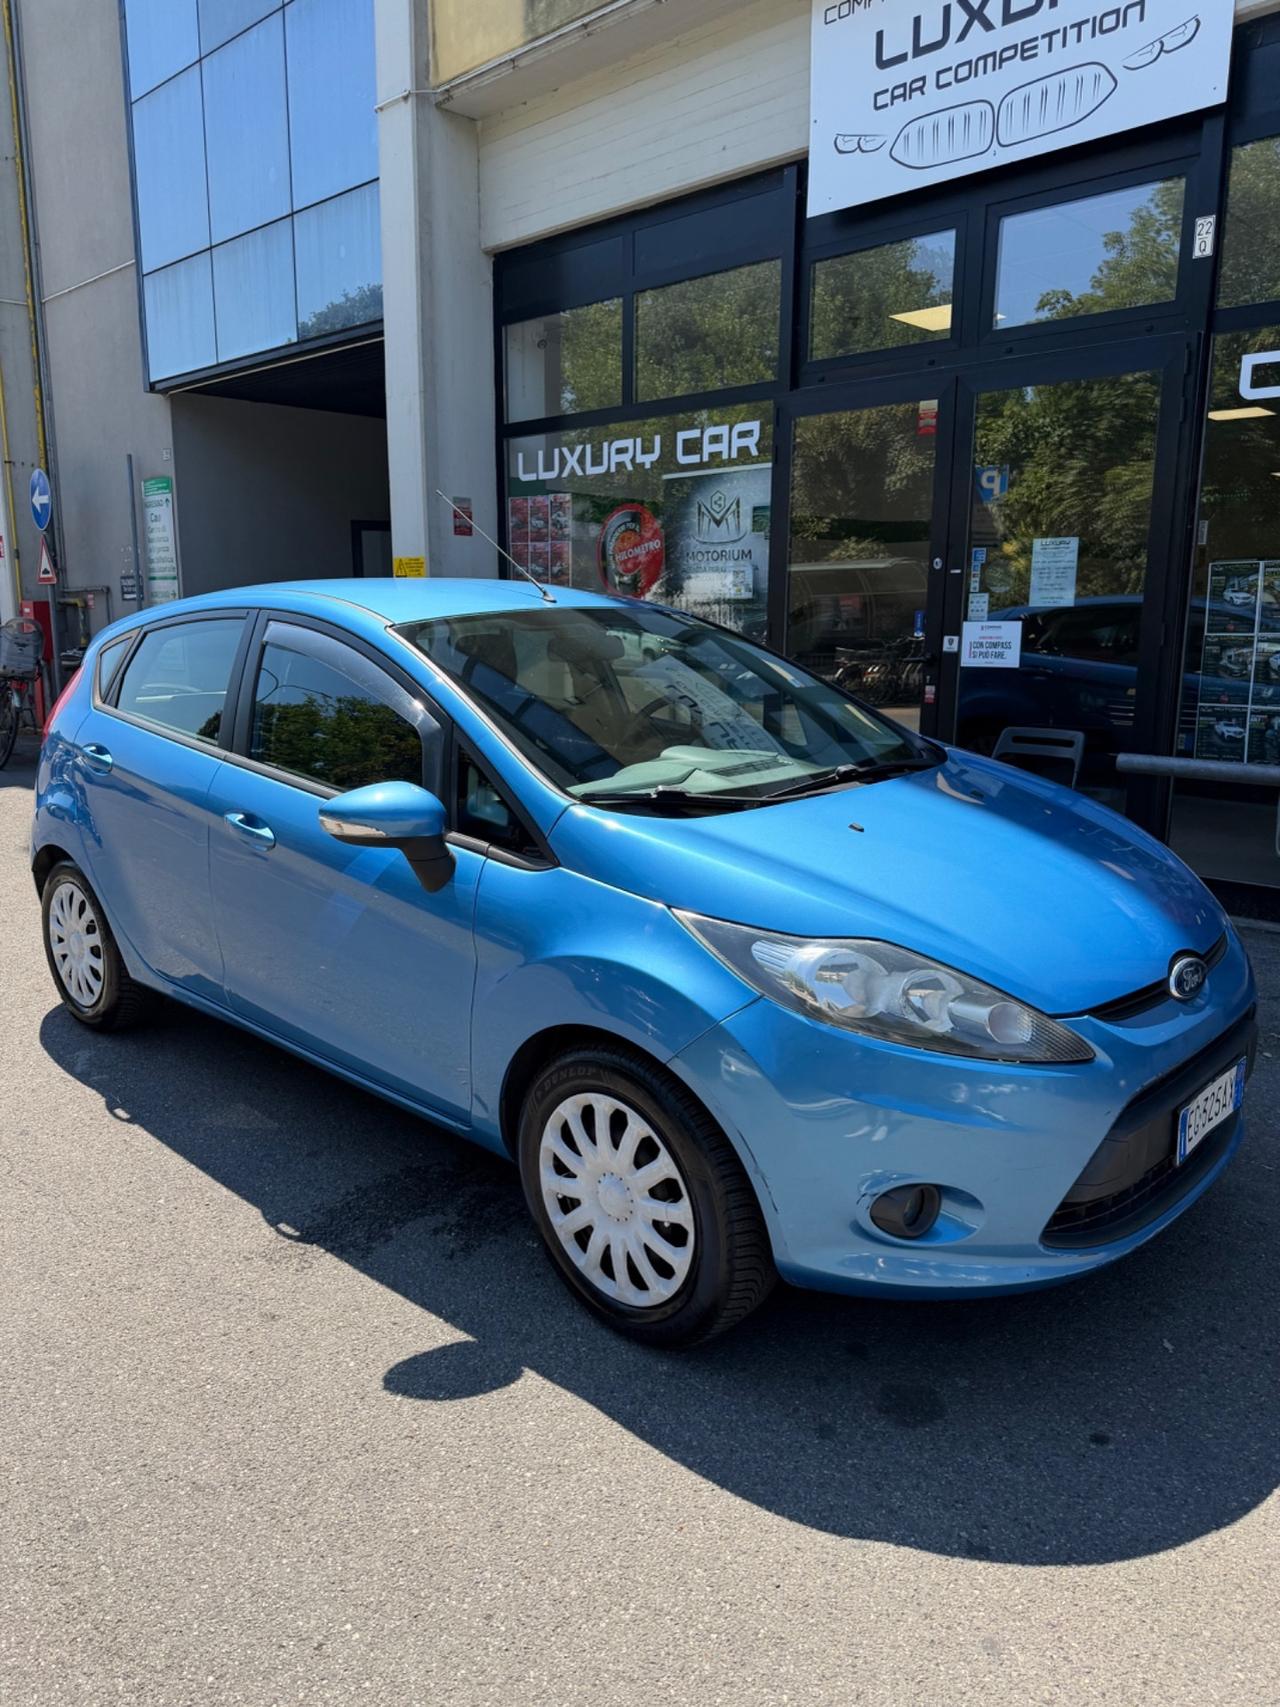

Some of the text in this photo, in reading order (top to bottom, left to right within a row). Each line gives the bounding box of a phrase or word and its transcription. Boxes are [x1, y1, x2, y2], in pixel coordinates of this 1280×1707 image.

[873, 0, 1145, 111] CAR COMPETITION
[1197, 220, 1213, 236] 22
[518, 420, 760, 482] LUXURY CAR
[686, 548, 752, 562] MOTORIUM
[972, 641, 1012, 650] CON COMPASS
